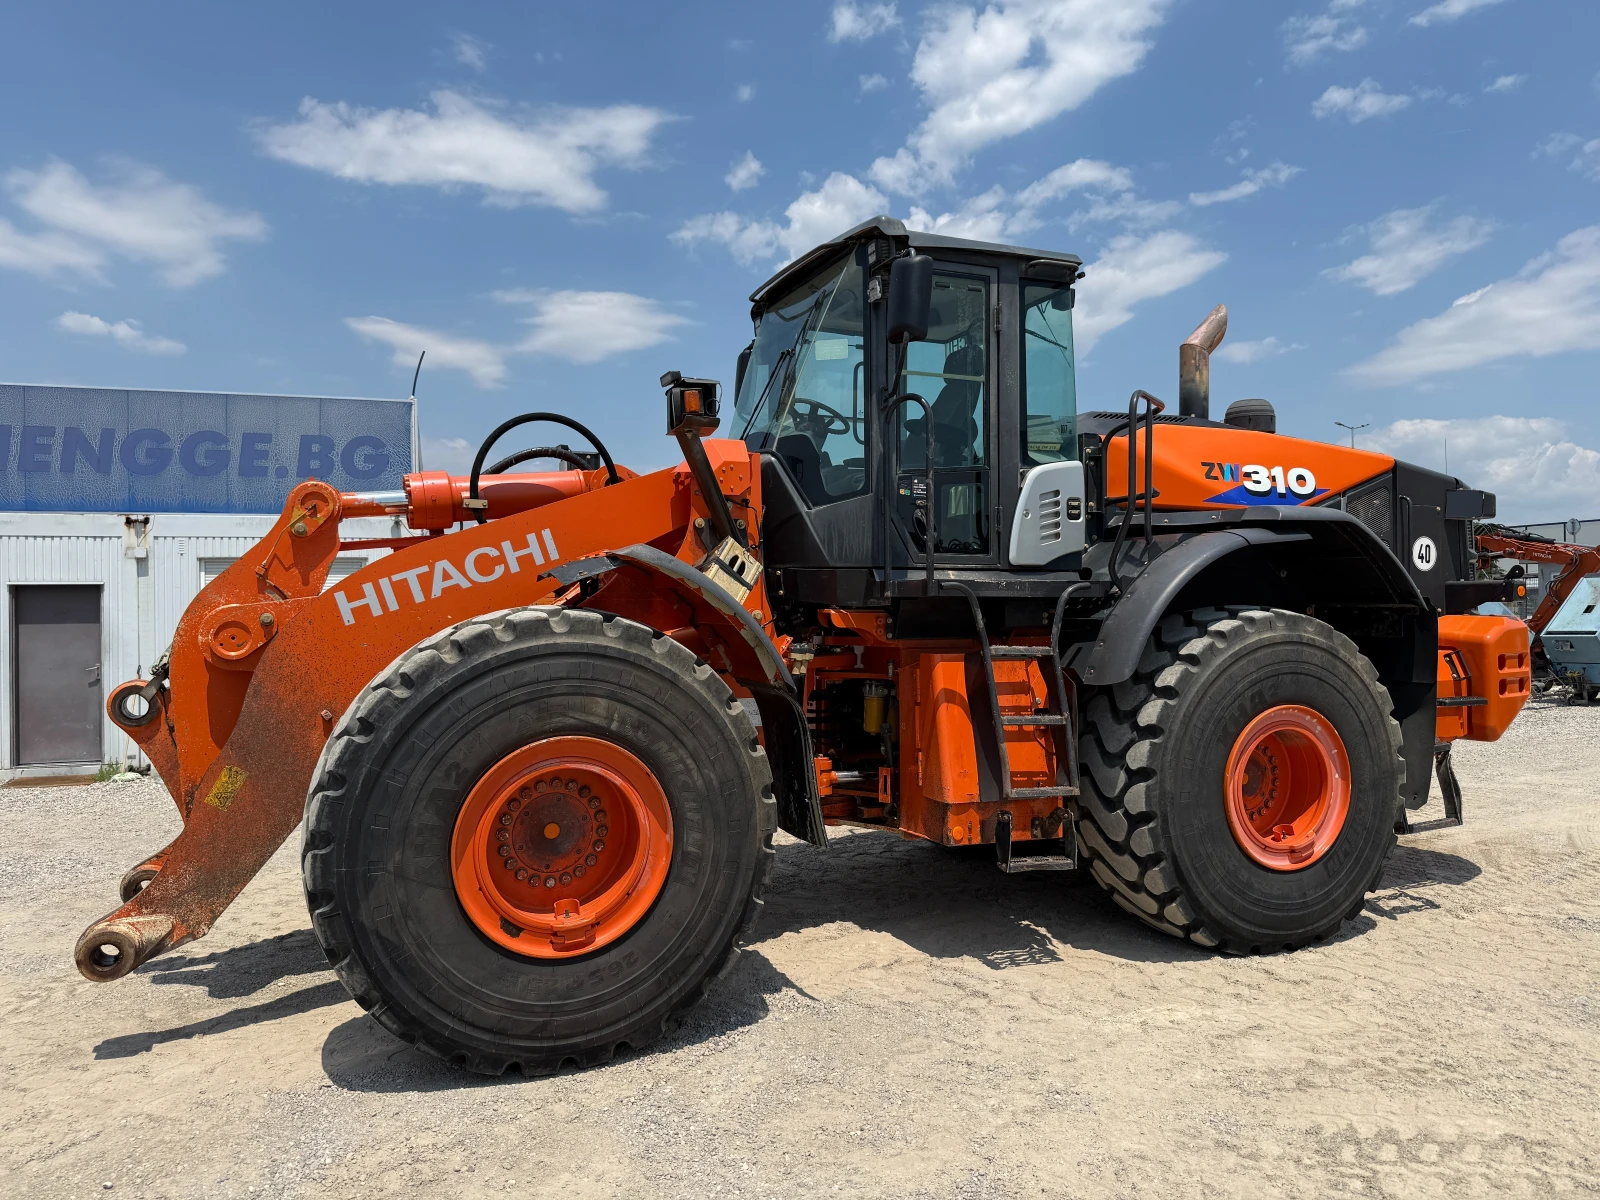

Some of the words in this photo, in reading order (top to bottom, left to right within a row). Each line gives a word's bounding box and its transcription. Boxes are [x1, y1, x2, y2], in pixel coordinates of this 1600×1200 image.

[0, 424, 389, 480] ENGGE.BG
[334, 528, 560, 626] HITACHI
[1417, 544, 1431, 564] 40
